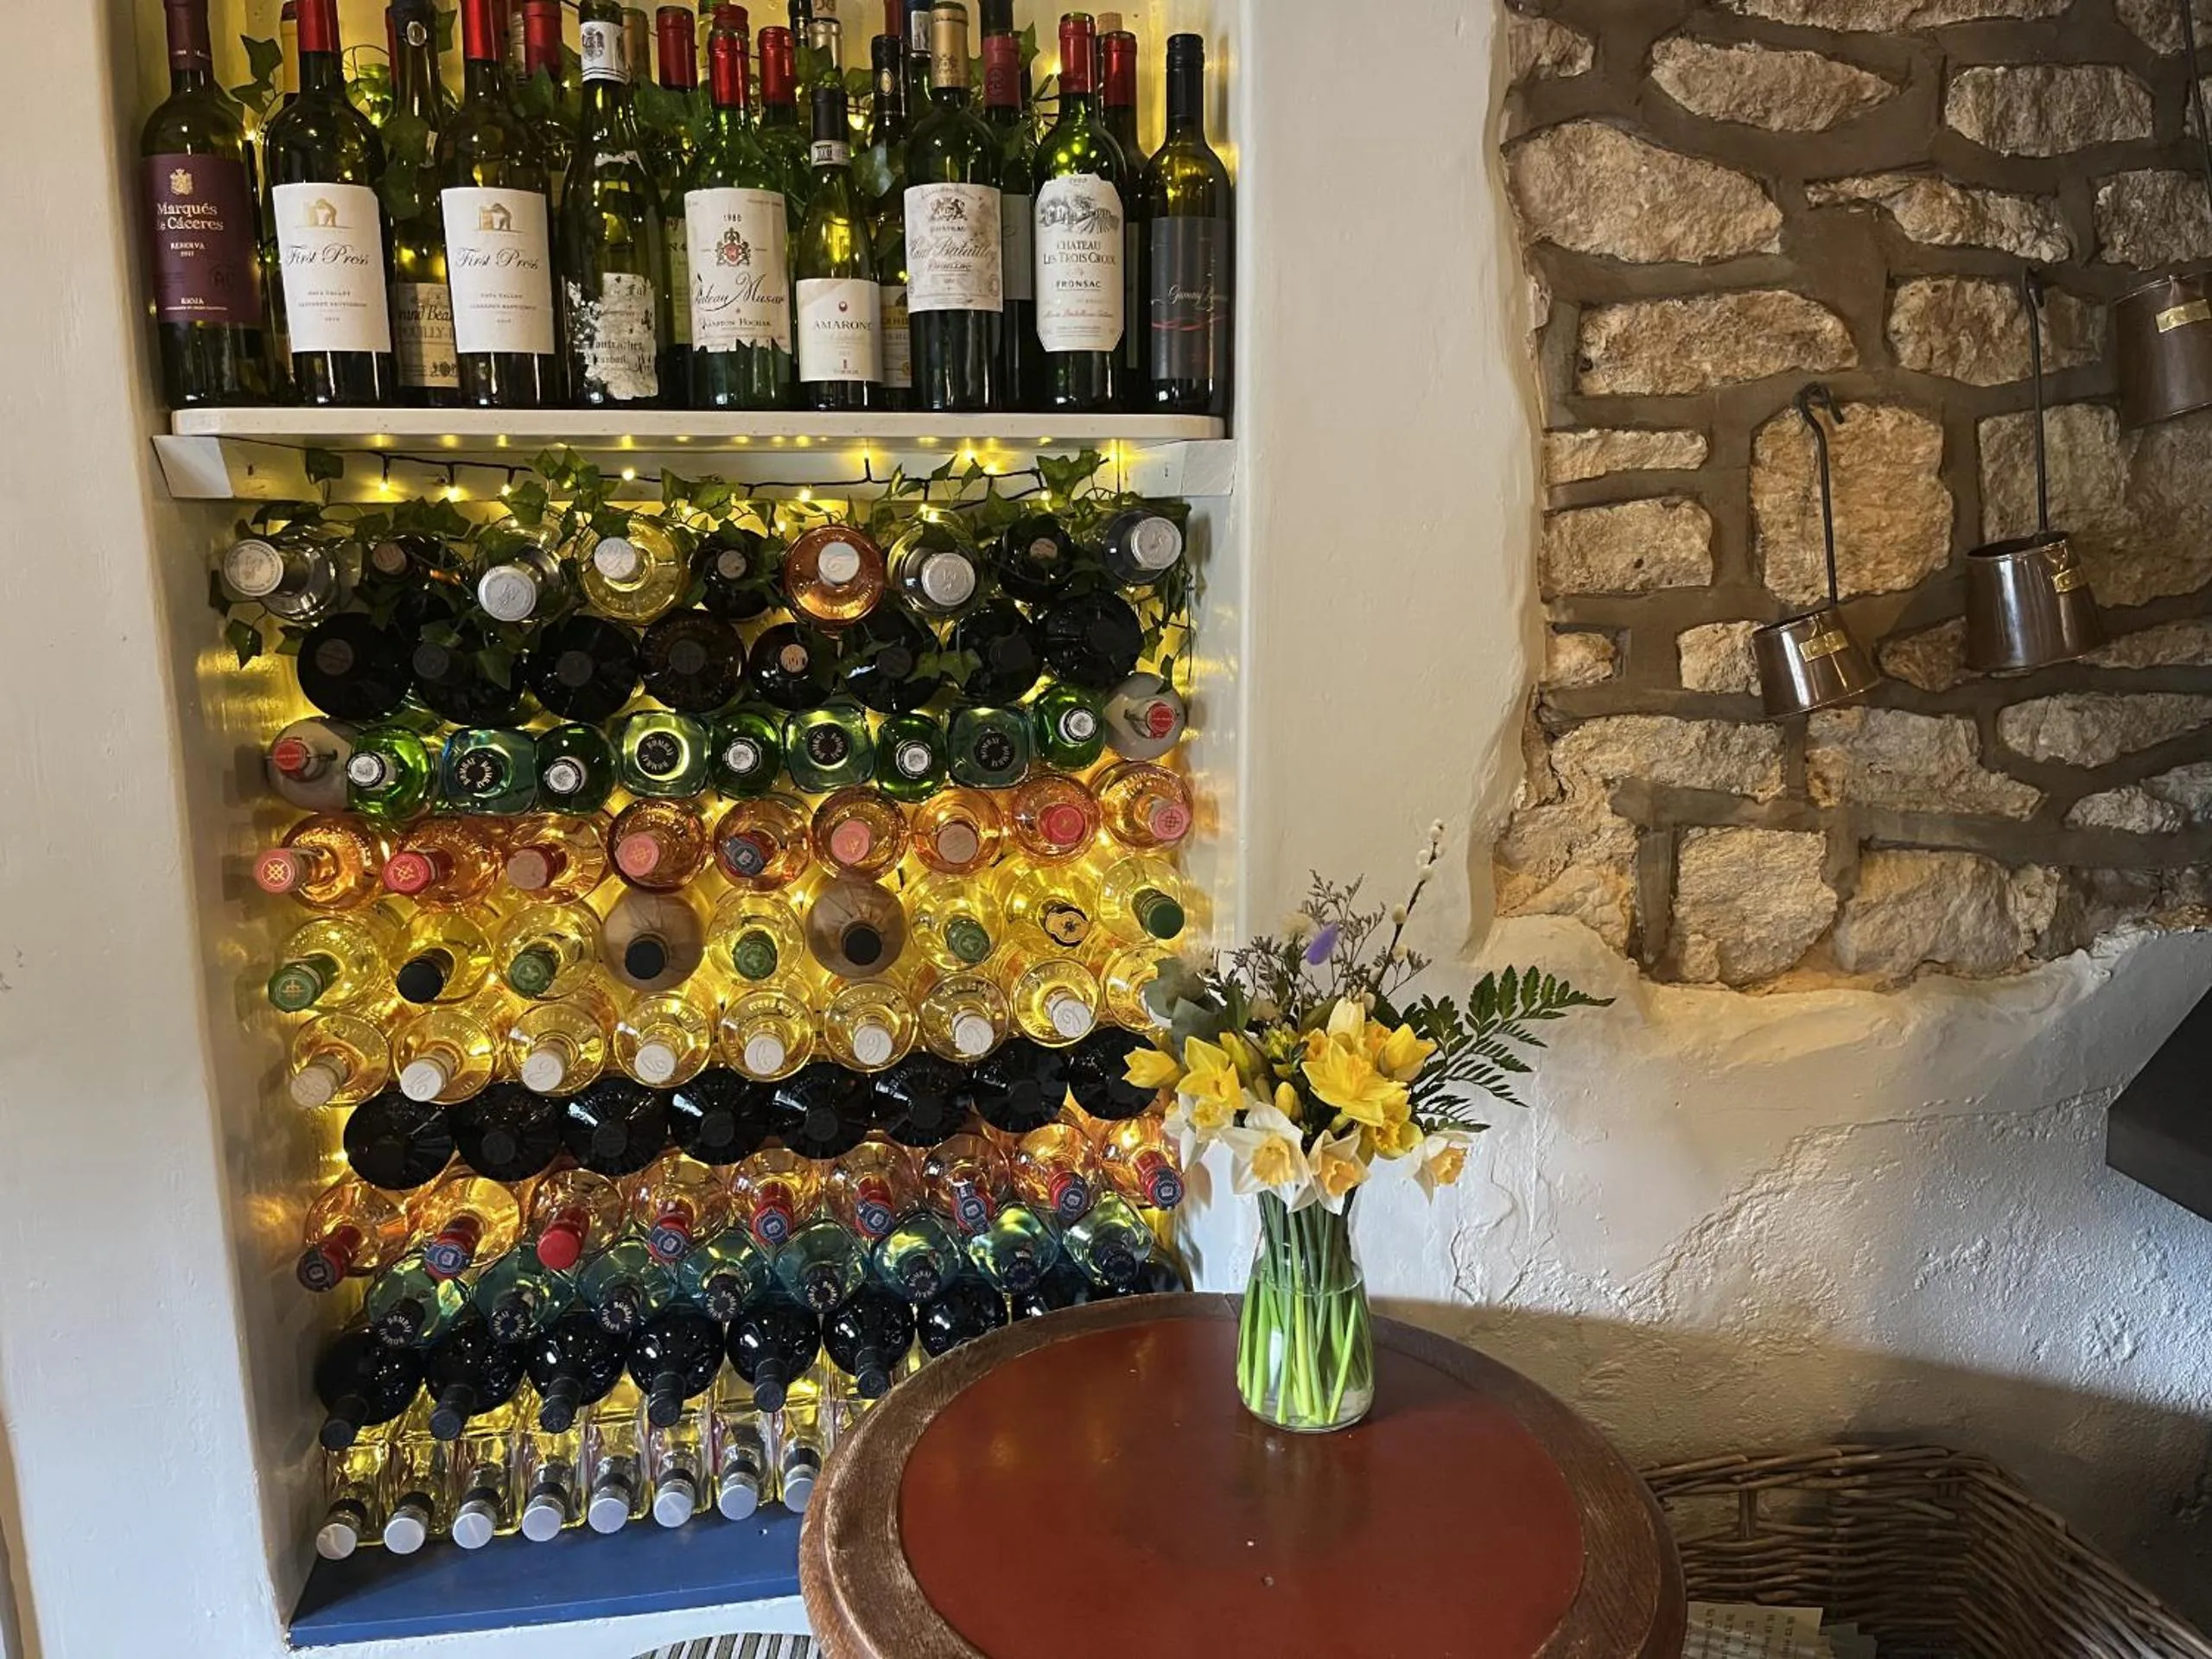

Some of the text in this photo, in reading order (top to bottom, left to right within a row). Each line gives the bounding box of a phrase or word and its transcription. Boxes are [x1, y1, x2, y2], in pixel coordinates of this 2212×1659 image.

[156, 202, 218, 217] Marqués
[167, 216, 224, 231] Cáceres
[1055, 280, 1103, 289] FRONSAC
